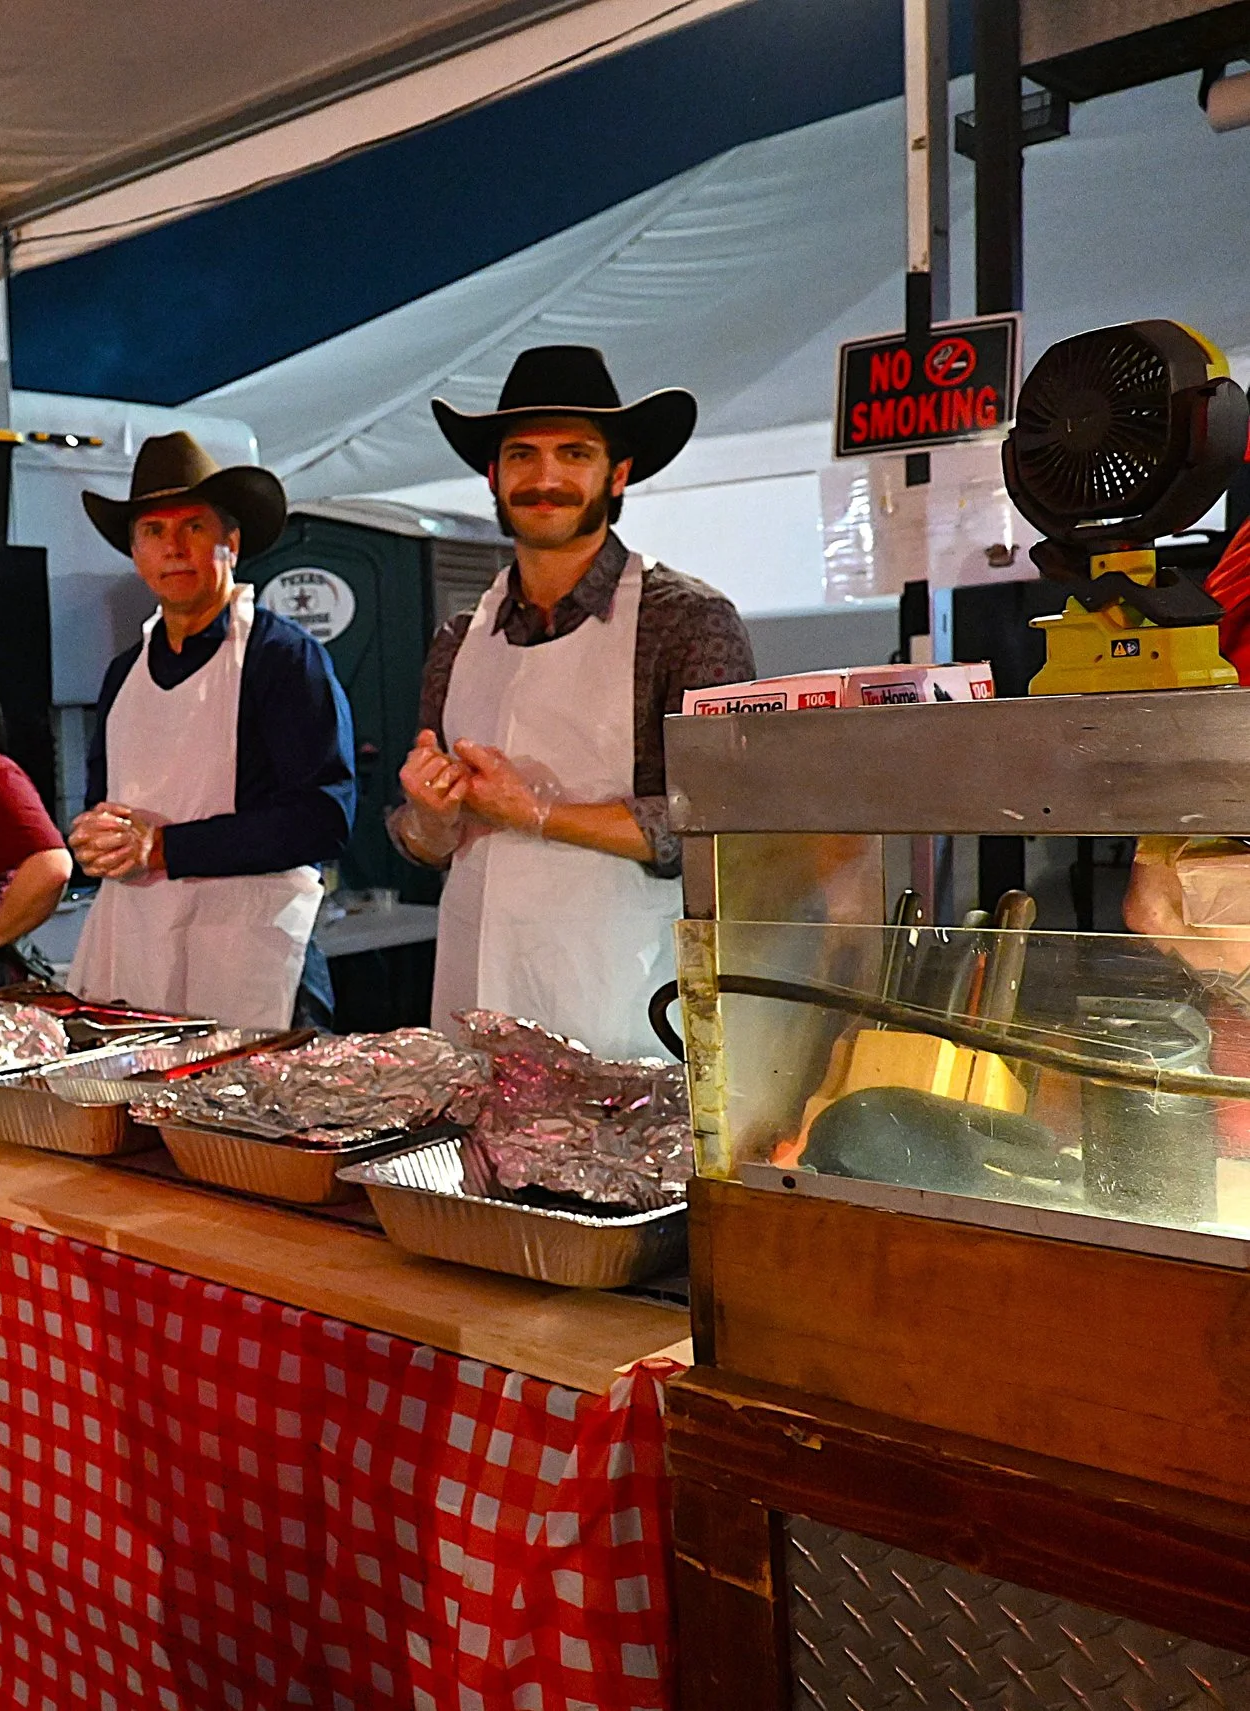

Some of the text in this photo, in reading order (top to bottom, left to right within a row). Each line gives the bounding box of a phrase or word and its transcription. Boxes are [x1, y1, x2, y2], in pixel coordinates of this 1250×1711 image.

[869, 349, 912, 394] NO
[851, 385, 998, 444] SMOKING
[698, 700, 783, 715] TruHome
